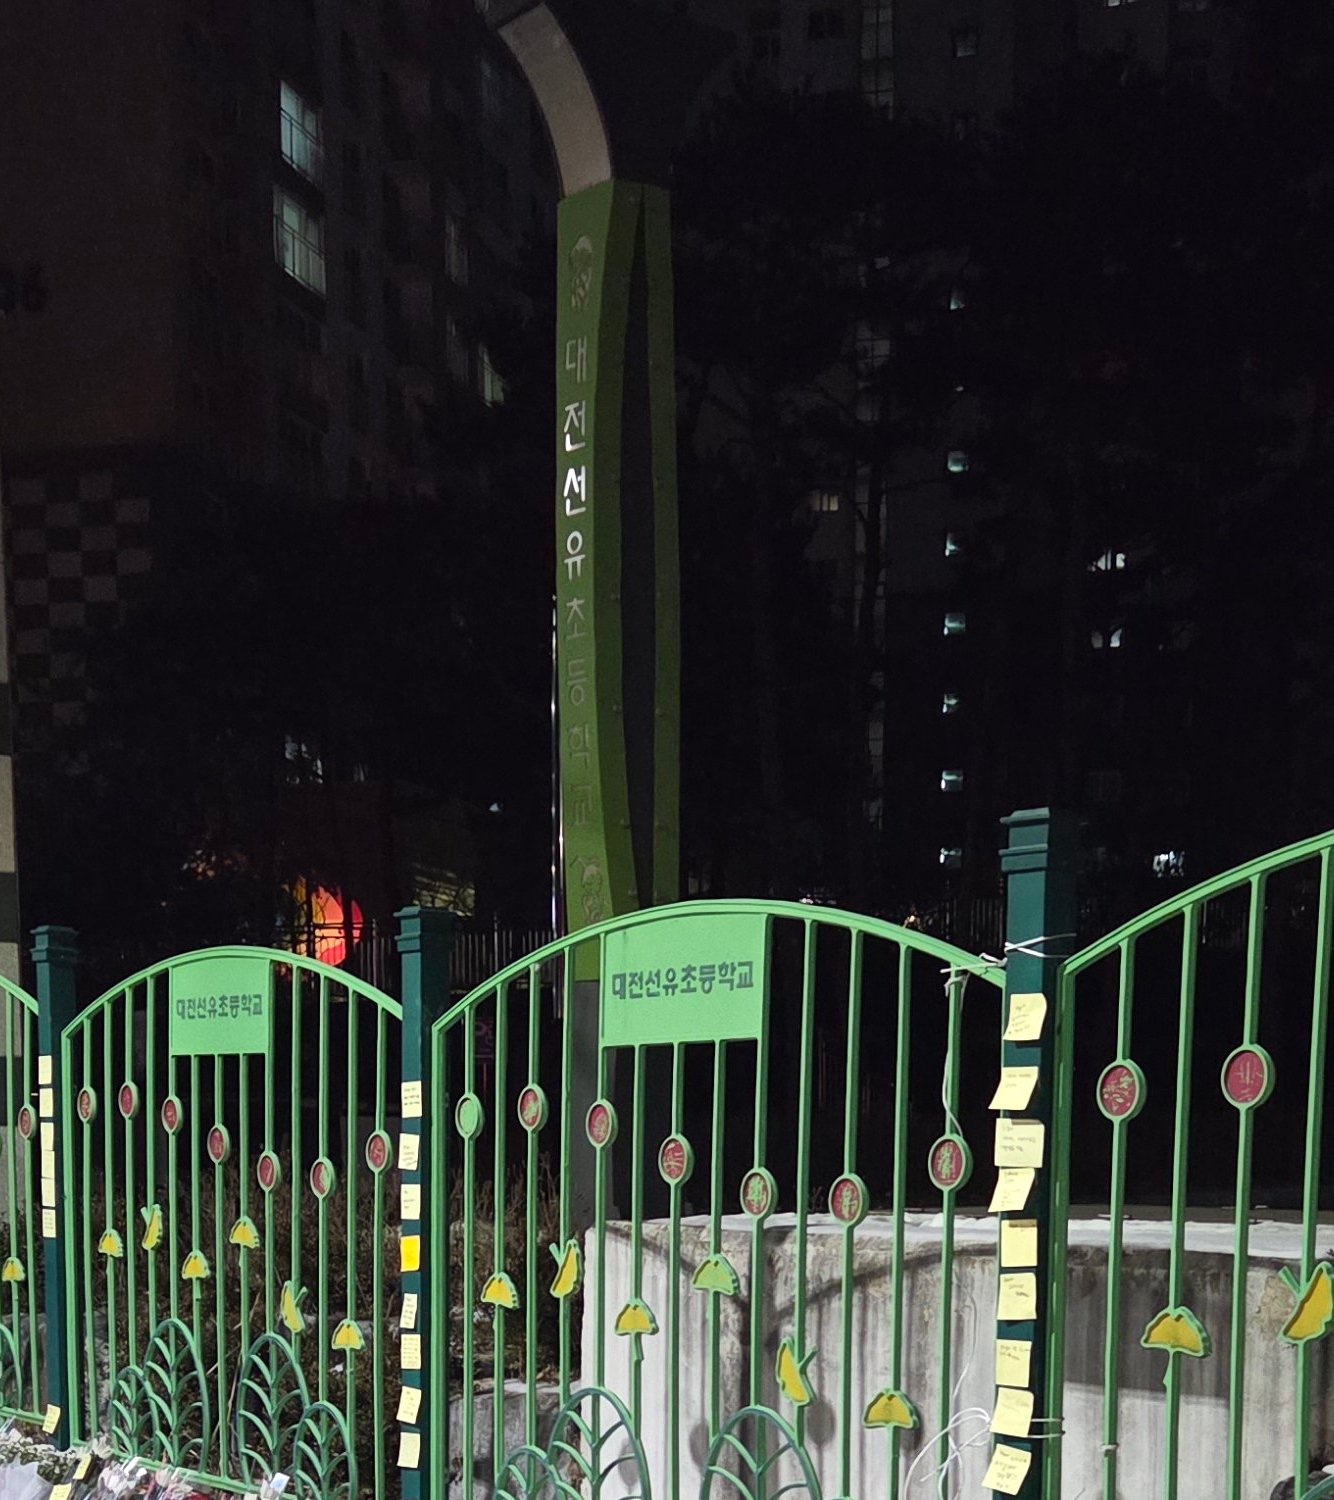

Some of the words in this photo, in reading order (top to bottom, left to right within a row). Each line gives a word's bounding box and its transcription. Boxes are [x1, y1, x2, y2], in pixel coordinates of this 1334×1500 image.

[563, 335, 591, 826] 대전선유초등학교
[612, 961, 754, 1000] 대전선유초등학교
[176, 994, 263, 1020] 대전선유초등학교
